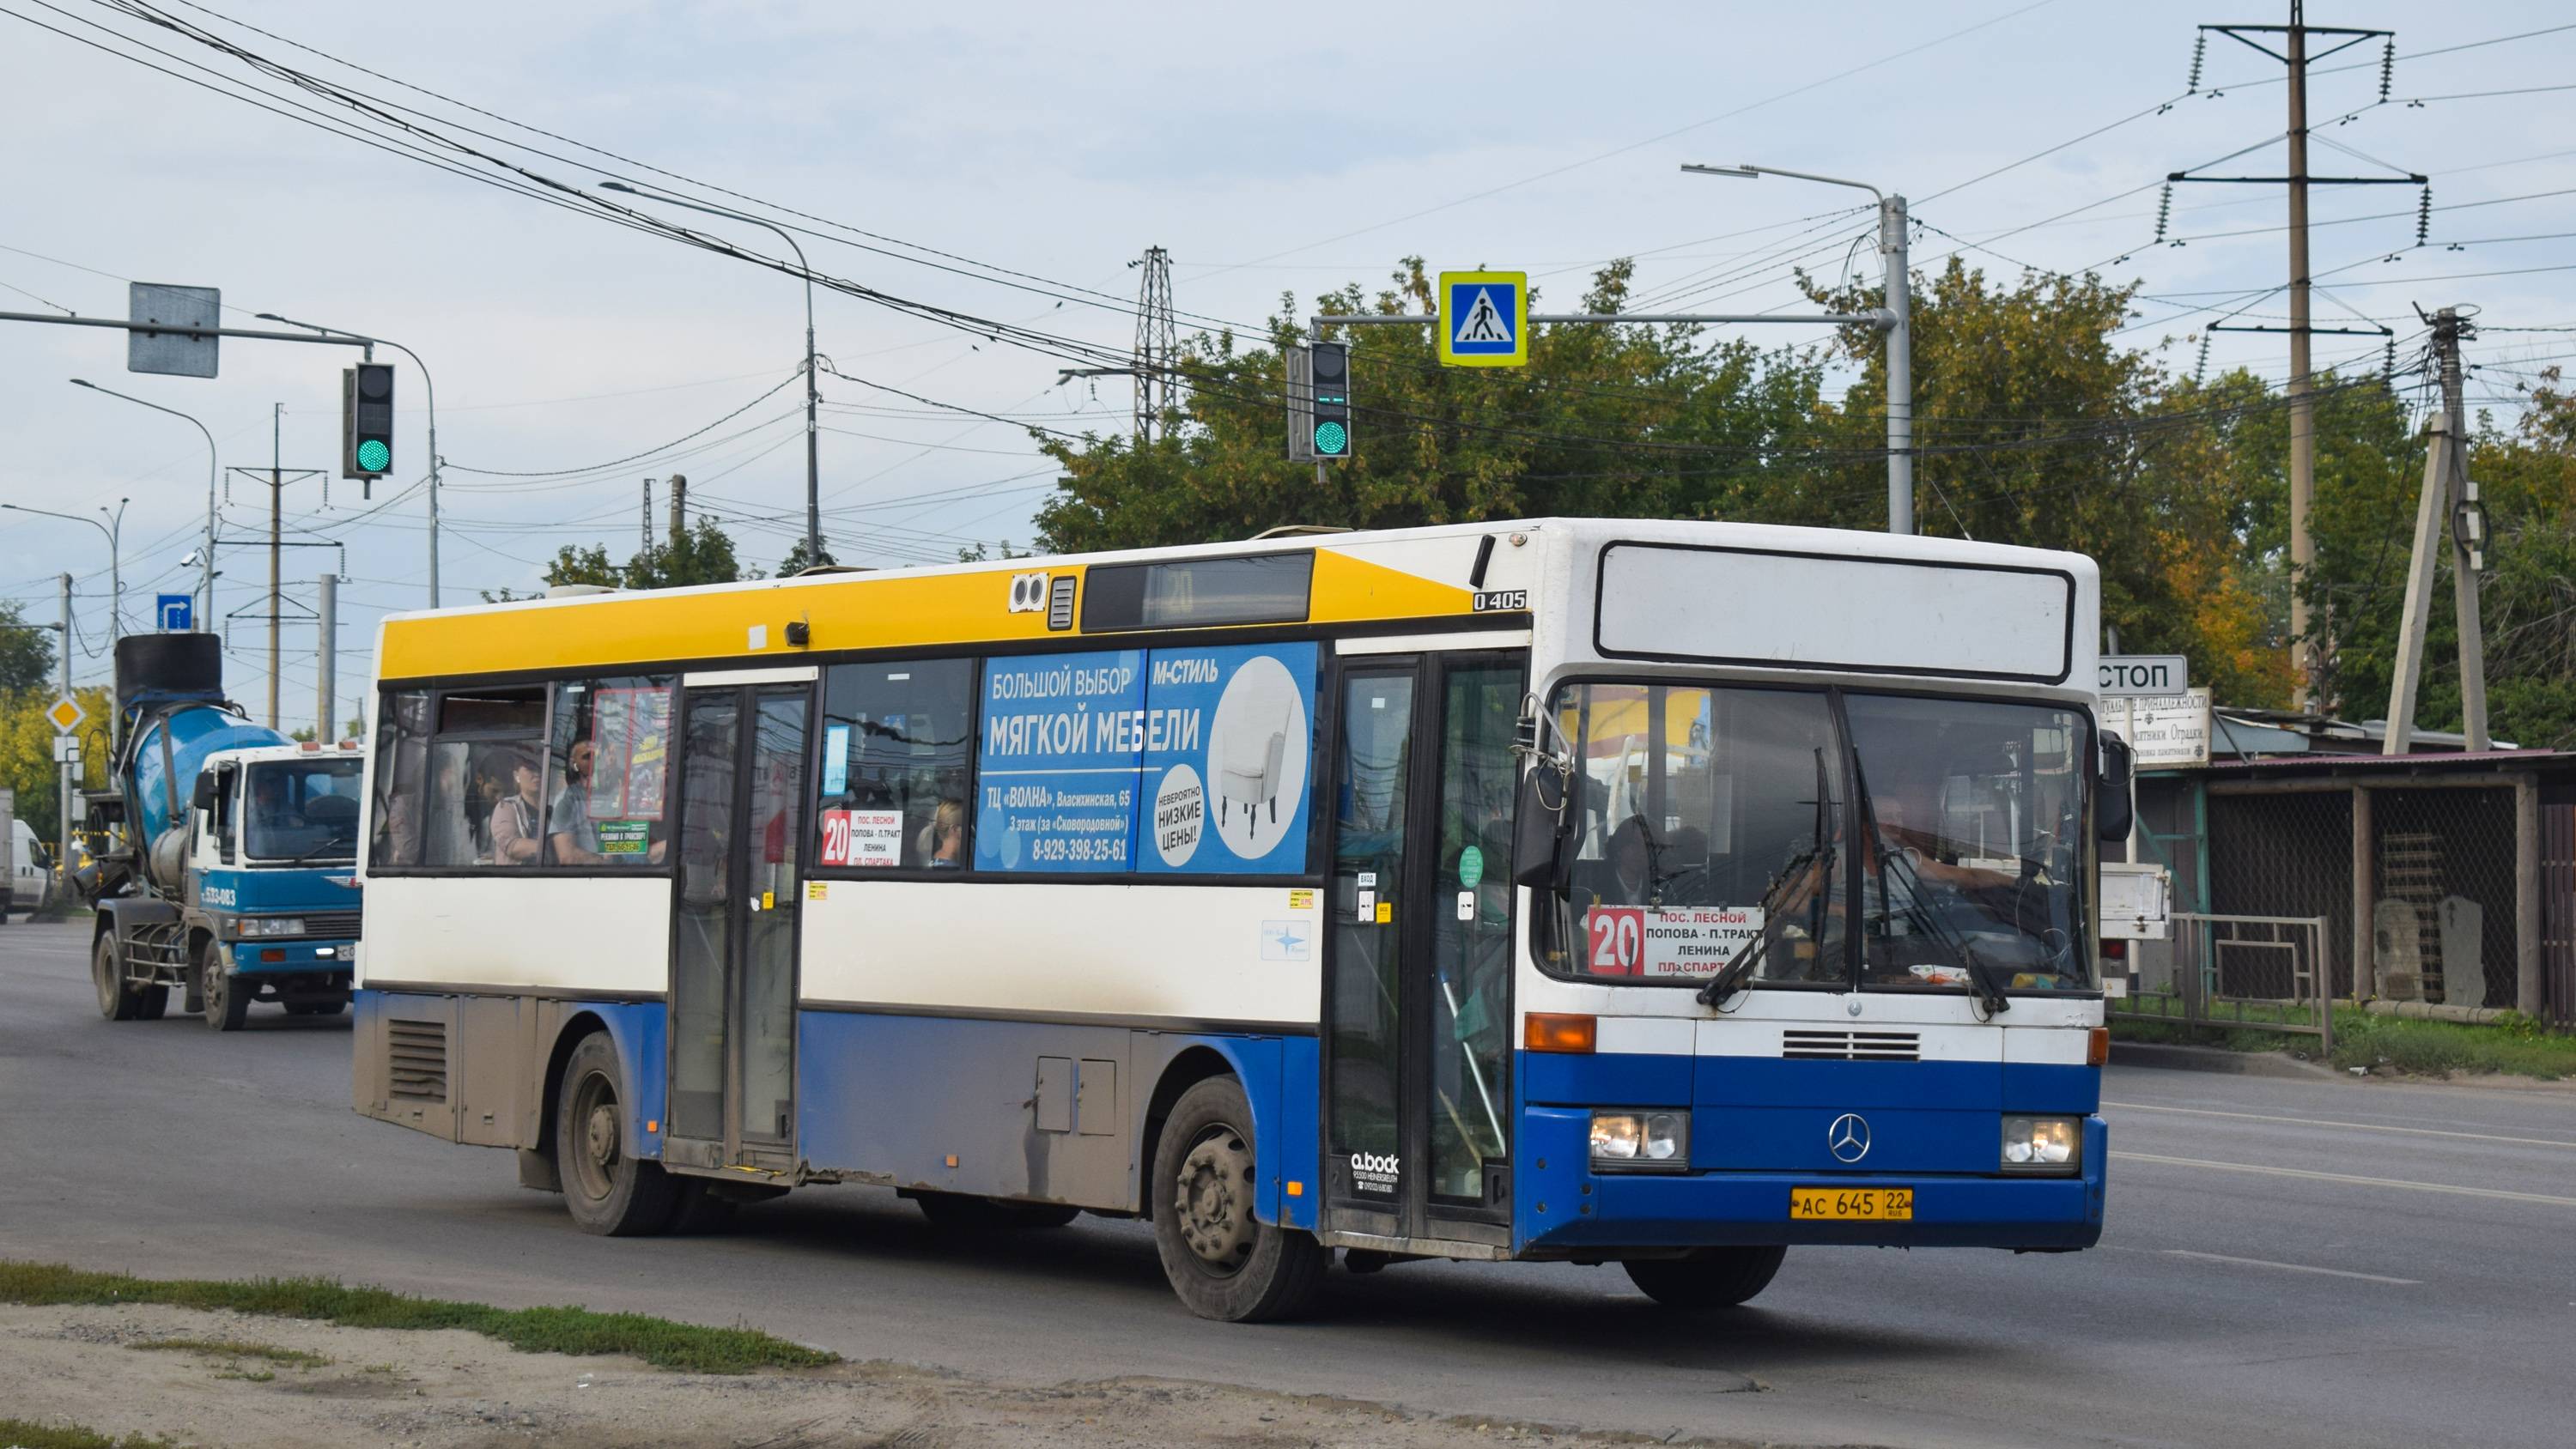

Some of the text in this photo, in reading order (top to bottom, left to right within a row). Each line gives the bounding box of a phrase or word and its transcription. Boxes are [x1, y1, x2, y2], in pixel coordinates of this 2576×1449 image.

[1489, 591, 1526, 609] 405
[993, 663, 1131, 700] БОЛЬШОЙ ВЫБОР
[1152, 658, 1219, 686] М-СТИЛЬ
[2099, 664, 2168, 688] СТОП
[989, 701, 1200, 756] МЯГКОЙ МЕБЕЛИ
[987, 786, 1001, 811] ТЦ
[1119, 790, 1130, 806] 65
[1158, 785, 1200, 806] НЕВЕРОЯТНО
[858, 815, 896, 825] ПОС. ЛЕСНОЙ
[1009, 815, 1016, 832] 3
[1017, 819, 1036, 832] этаж
[1037, 815, 1050, 834] (за
[1158, 800, 1201, 828] НИЗКИЕ
[823, 817, 848, 862] 20
[851, 829, 874, 838] ПОПОВА
[878, 829, 901, 839] П.ТРАКТ
[1162, 825, 1198, 852] ЦЕНЫ!
[863, 843, 887, 852] ЛЕНИНА
[1032, 838, 1127, 861] 8-929-398-25-61
[865, 858, 894, 866] СПАРТАКА
[1660, 912, 1747, 924] ПОС. ЛЕСНОЙ
[1594, 914, 1639, 967] 20
[1645, 928, 1698, 939] ПОПОВА
[1677, 945, 1730, 956] ЛЕНИНА
[1683, 962, 1725, 973] СПАРТ
[1352, 1152, 1400, 1173] a.bock
[1801, 1192, 1874, 1216] АС 645
[1886, 1191, 1905, 1210] 22
